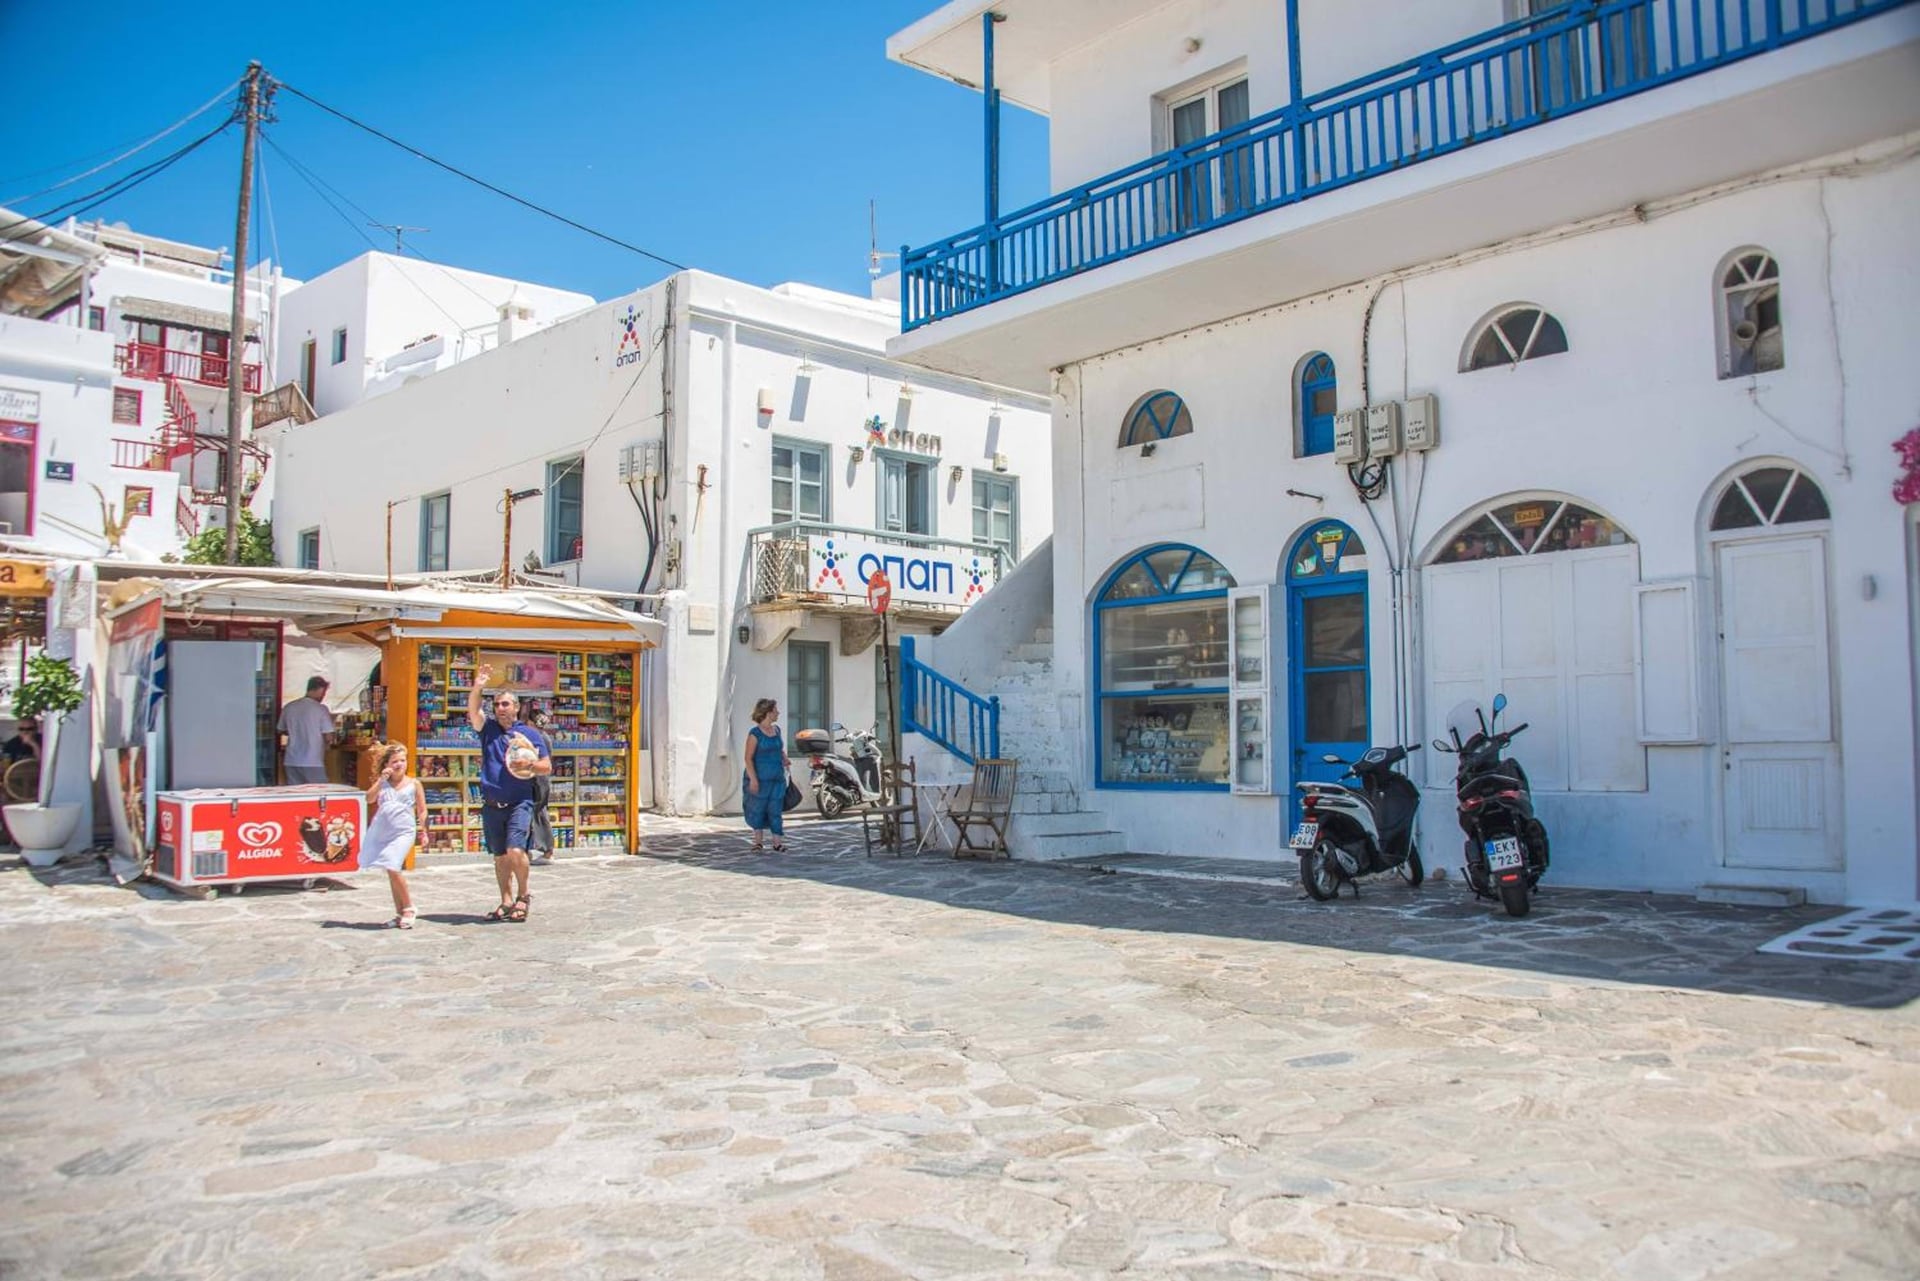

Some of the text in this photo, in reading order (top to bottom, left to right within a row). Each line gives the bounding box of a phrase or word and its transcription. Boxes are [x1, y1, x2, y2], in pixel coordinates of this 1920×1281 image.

[1495, 840, 1516, 853] EKY
[237, 848, 282, 860] ALGIDA
[1497, 853, 1520, 866] 723
